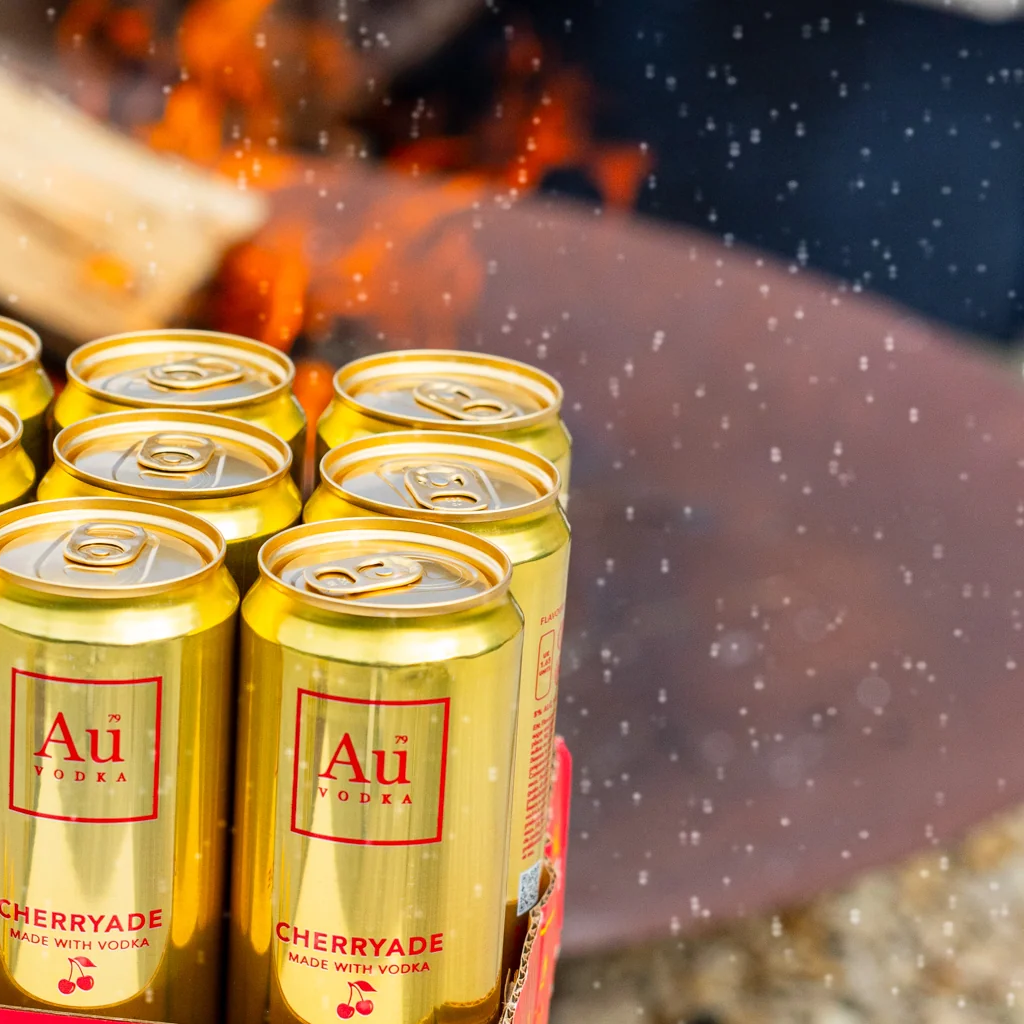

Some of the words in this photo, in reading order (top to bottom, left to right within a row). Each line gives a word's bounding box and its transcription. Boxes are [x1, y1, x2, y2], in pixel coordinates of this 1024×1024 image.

[108, 713, 122, 723] 79
[33, 711, 125, 765] Au
[394, 734, 408, 744] 79
[318, 732, 412, 786] Au
[33, 765, 128, 783] VODKA
[317, 787, 413, 805] VODKA
[9, 928, 50, 948] MADE
[54, 938, 94, 950] WITH
[97, 935, 151, 950] VODKA
[275, 921, 444, 958] CHERRYADE
[288, 951, 328, 971] MADE
[334, 961, 374, 975] WITH
[377, 960, 431, 974] VODKA
